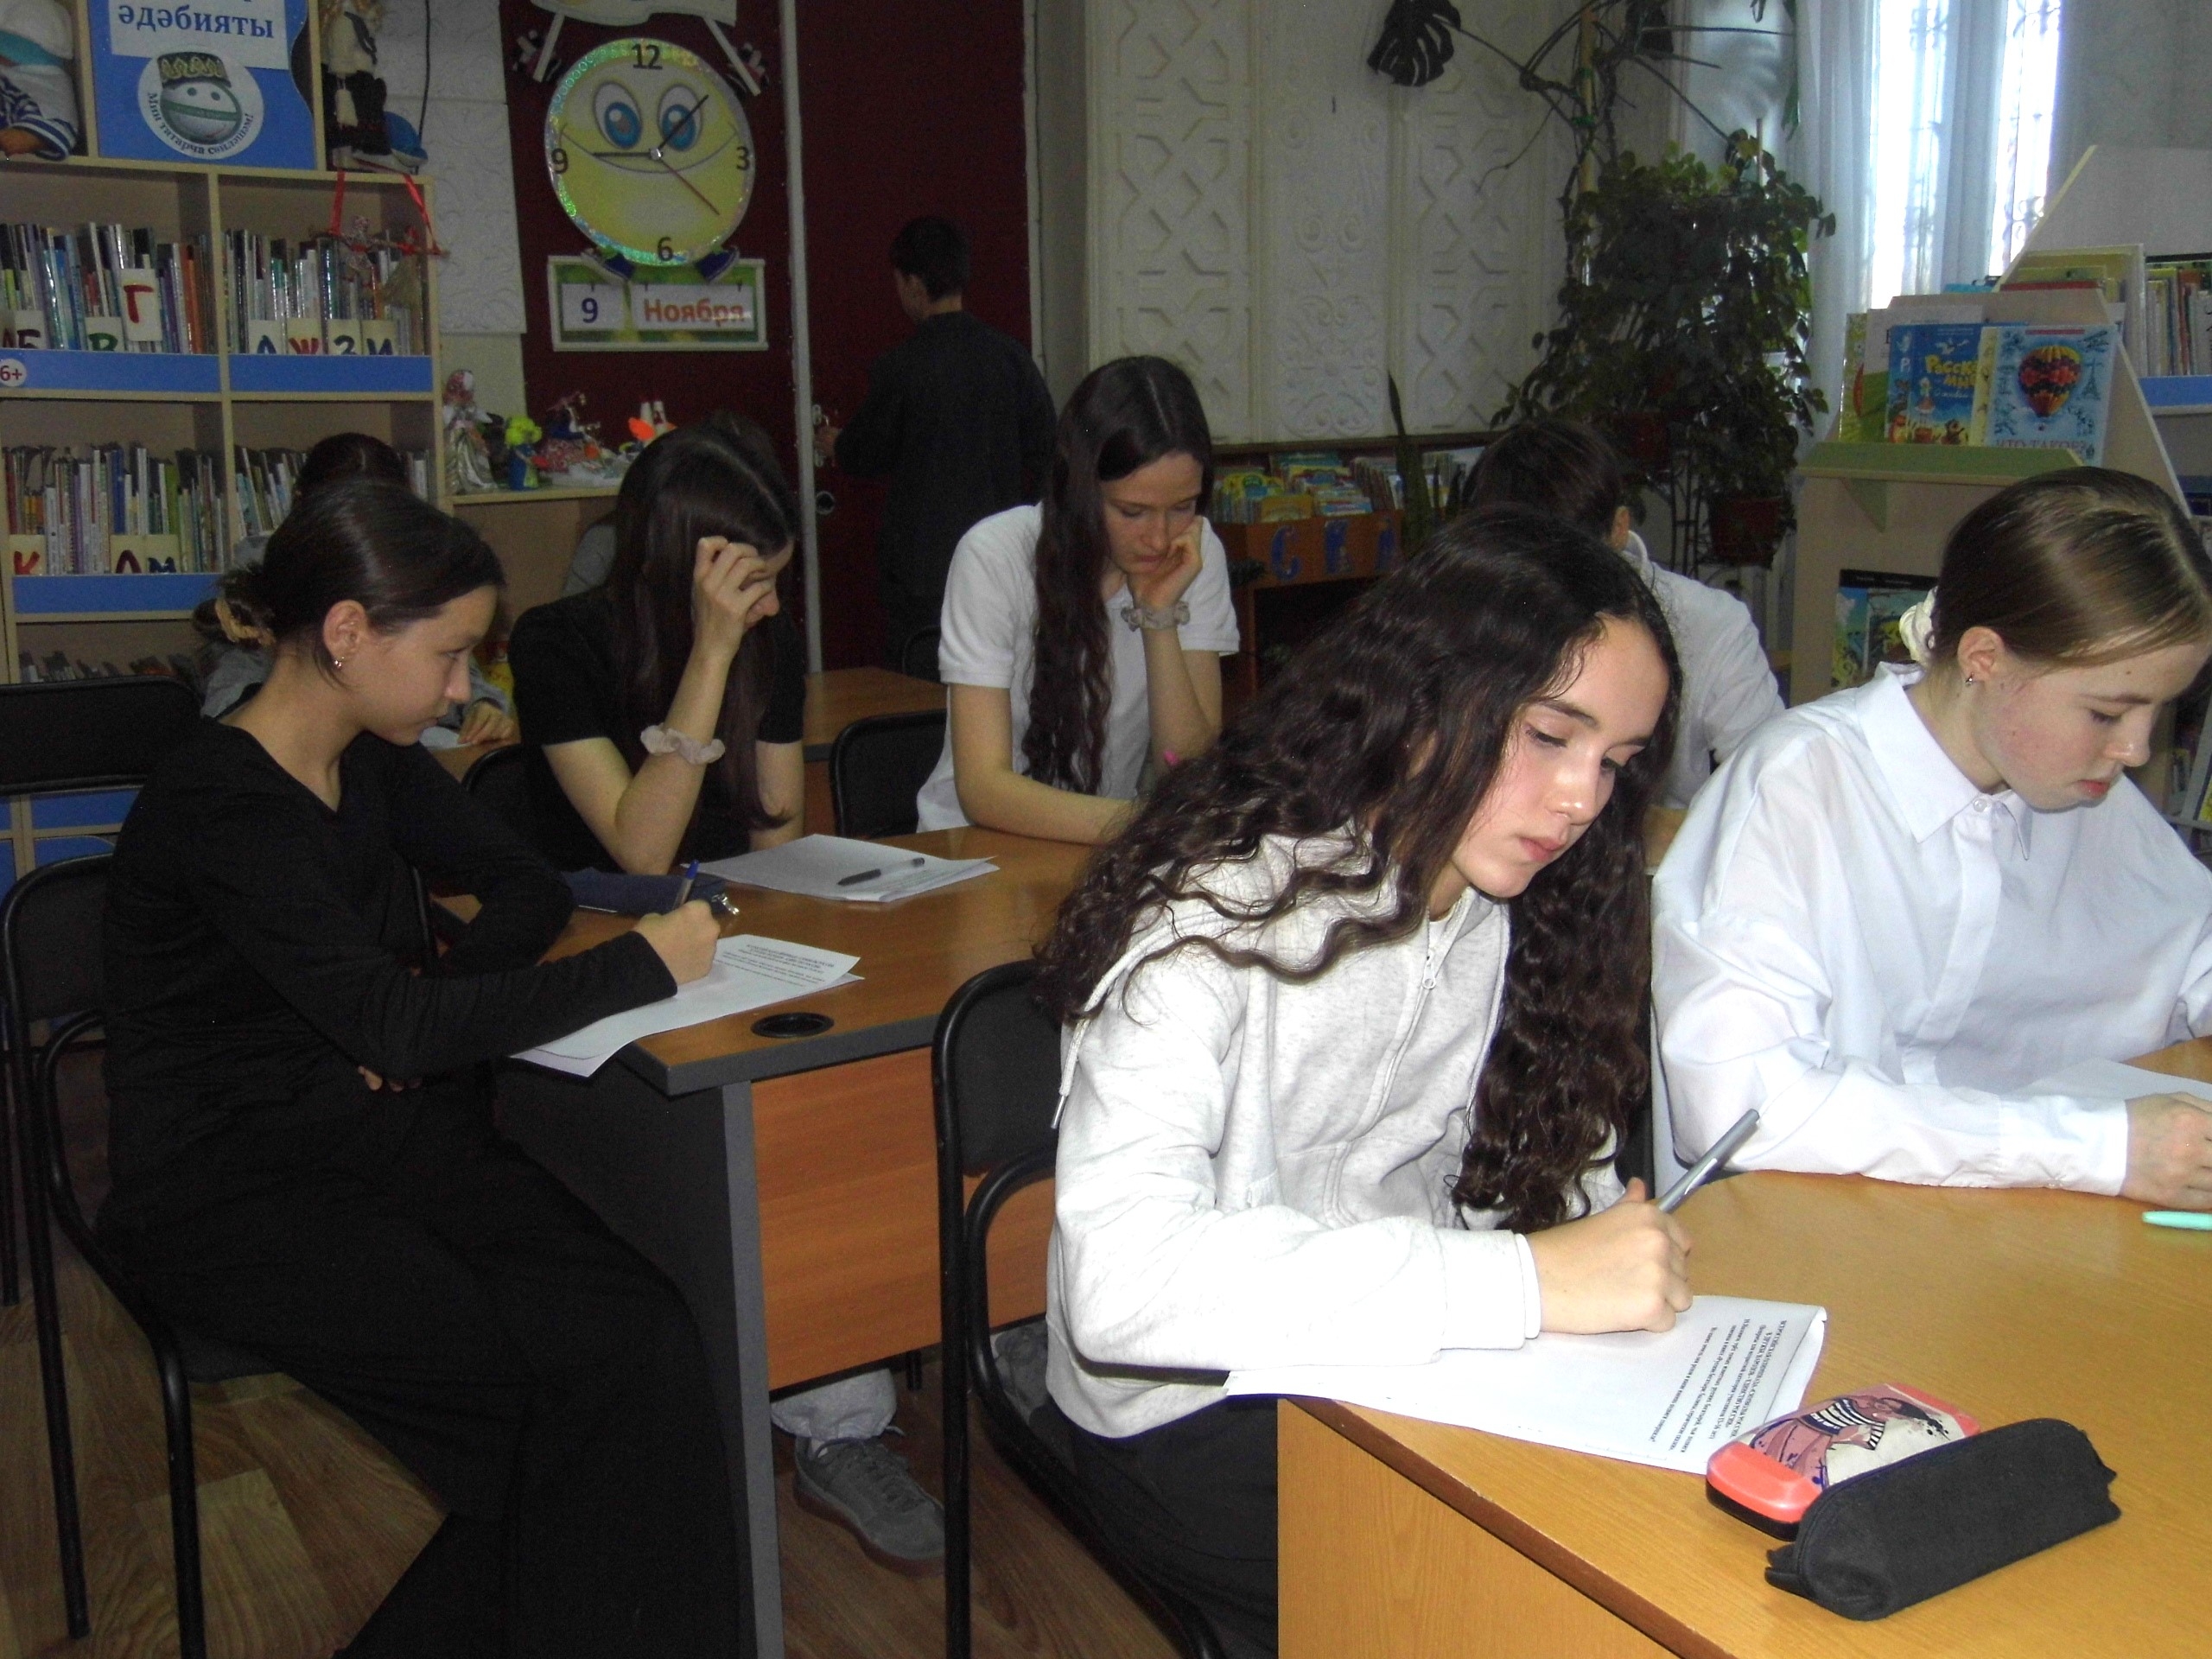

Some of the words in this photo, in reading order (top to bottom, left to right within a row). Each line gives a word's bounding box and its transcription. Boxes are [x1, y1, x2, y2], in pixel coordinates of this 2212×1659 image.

[118, 4, 274, 38] әдәбияты
[632, 43, 663, 70] 12
[147, 92, 162, 121] Мин
[159, 123, 205, 155] татарча
[552, 148, 569, 174] 9
[735, 147, 751, 171] 3
[657, 237, 674, 262] 6
[124, 284, 154, 324] Г
[581, 297, 599, 324] 9
[643, 296, 745, 327] Ноября
[0, 365, 22, 381] 6+
